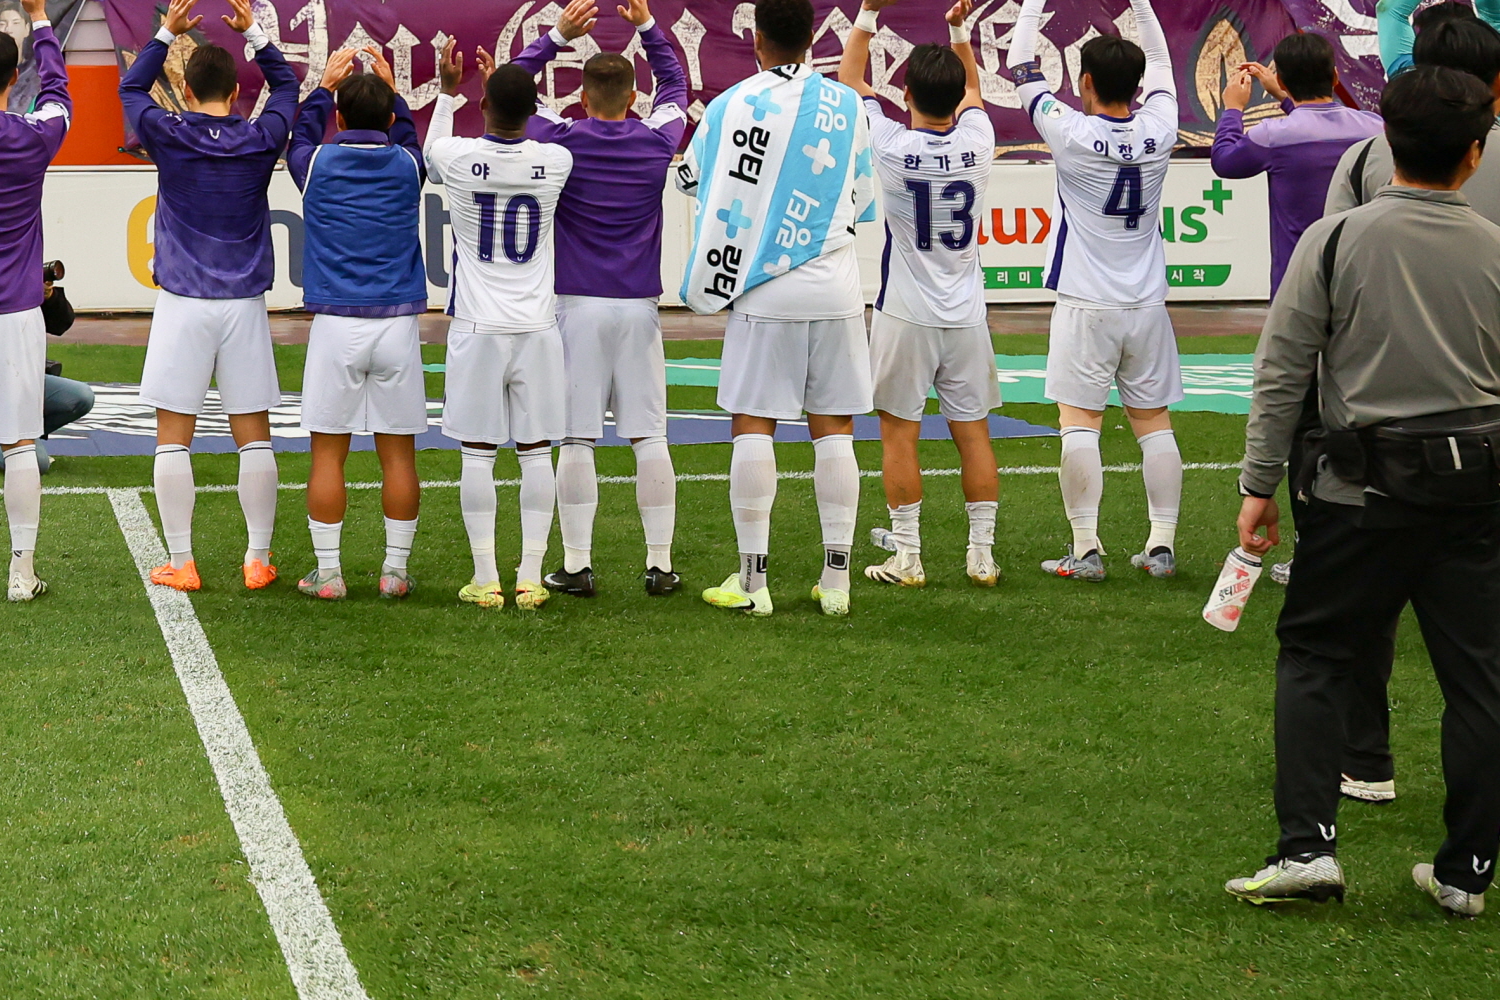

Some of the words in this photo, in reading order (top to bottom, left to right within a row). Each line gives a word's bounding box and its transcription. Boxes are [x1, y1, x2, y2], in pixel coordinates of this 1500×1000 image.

[904, 151, 976, 172] 한가람
[1093, 138, 1158, 161] 이창용
[473, 191, 542, 264] 10
[904, 179, 976, 252] 13
[1101, 165, 1147, 231] 4
